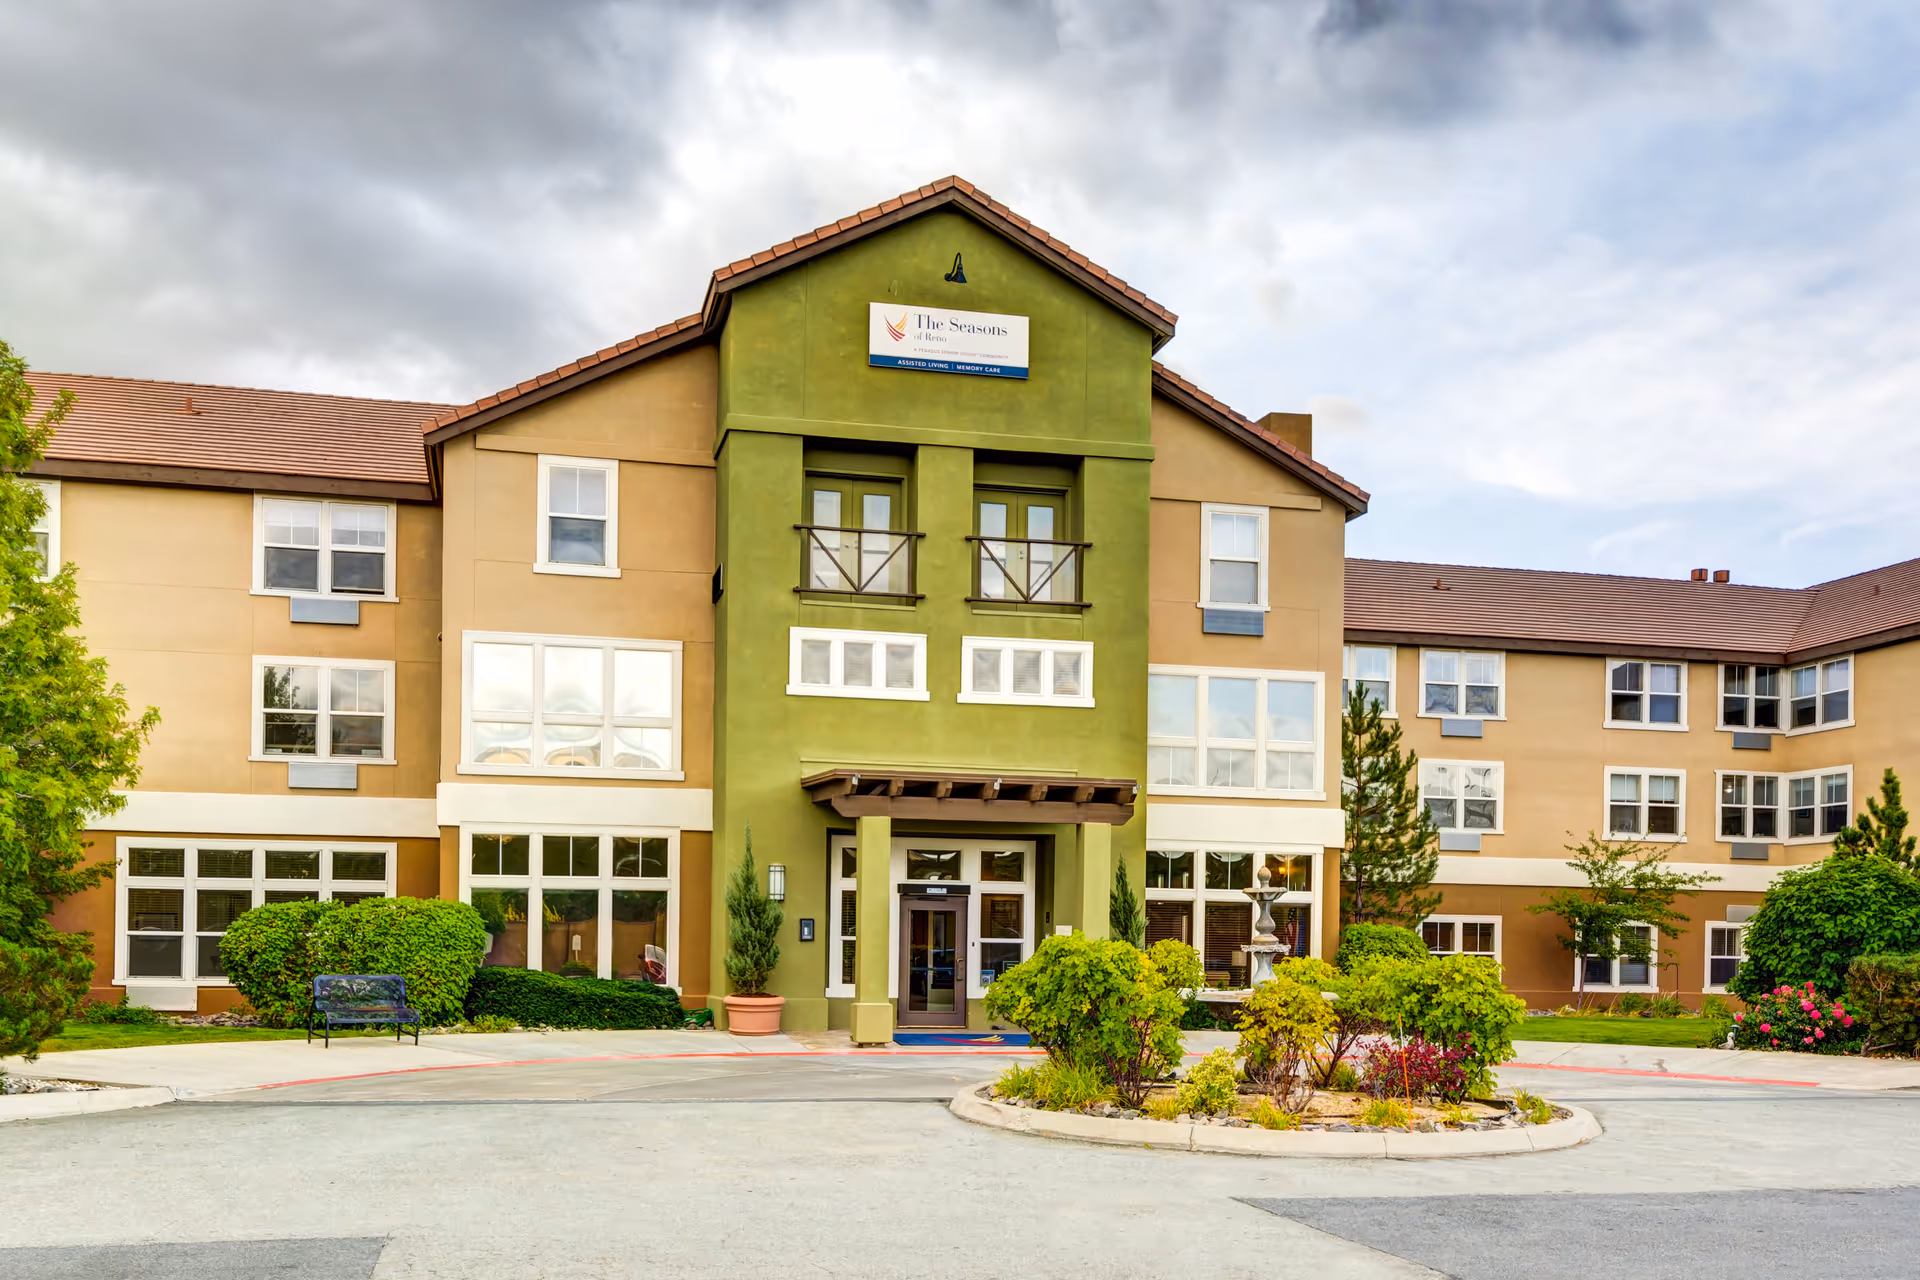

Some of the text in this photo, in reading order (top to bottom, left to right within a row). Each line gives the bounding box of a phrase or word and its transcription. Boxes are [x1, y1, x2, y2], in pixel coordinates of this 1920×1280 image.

[914, 313, 1008, 337] The Seasons
[914, 331, 947, 343] of Reno
[897, 359, 927, 367] ASSISTED
[928, 361, 949, 369] LIVING
[956, 364, 983, 372] MEMORY
